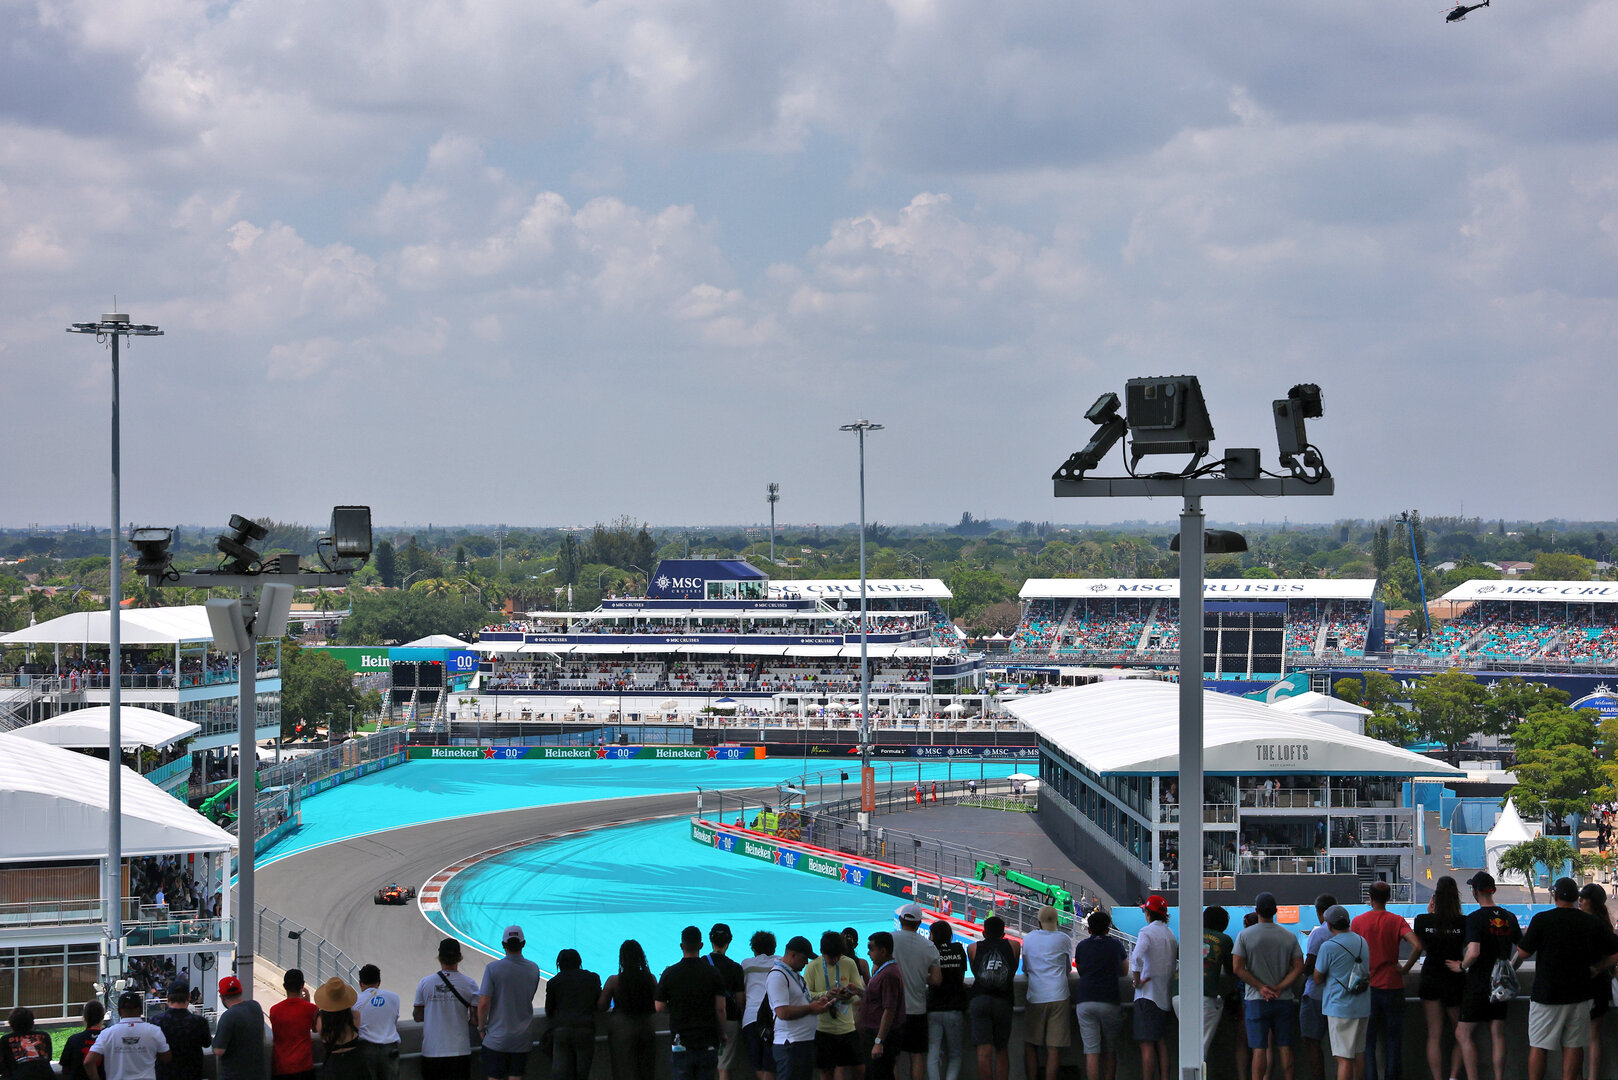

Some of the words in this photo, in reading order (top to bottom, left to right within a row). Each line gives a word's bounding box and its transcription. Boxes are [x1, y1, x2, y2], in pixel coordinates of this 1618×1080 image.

[671, 577, 702, 588] MSC
[1117, 584, 1173, 592] MSC
[1203, 583, 1304, 592] RUISES
[806, 584, 925, 593] CRUISES
[1501, 586, 1557, 595] MSC
[457, 656, 472, 667] 0.0
[431, 748, 478, 757] Heineken
[544, 748, 591, 757] Heineken
[656, 748, 701, 757] Heineken
[811, 746, 830, 754] Miami
[1256, 745, 1275, 761] THE
[1277, 745, 1309, 761] LOFTS
[693, 827, 712, 844] Heineken
[744, 842, 772, 860] Heineken
[808, 858, 837, 877] Heineken
[876, 875, 891, 890] Miami
[986, 960, 1003, 970] EF
[372, 997, 385, 1007] hp
